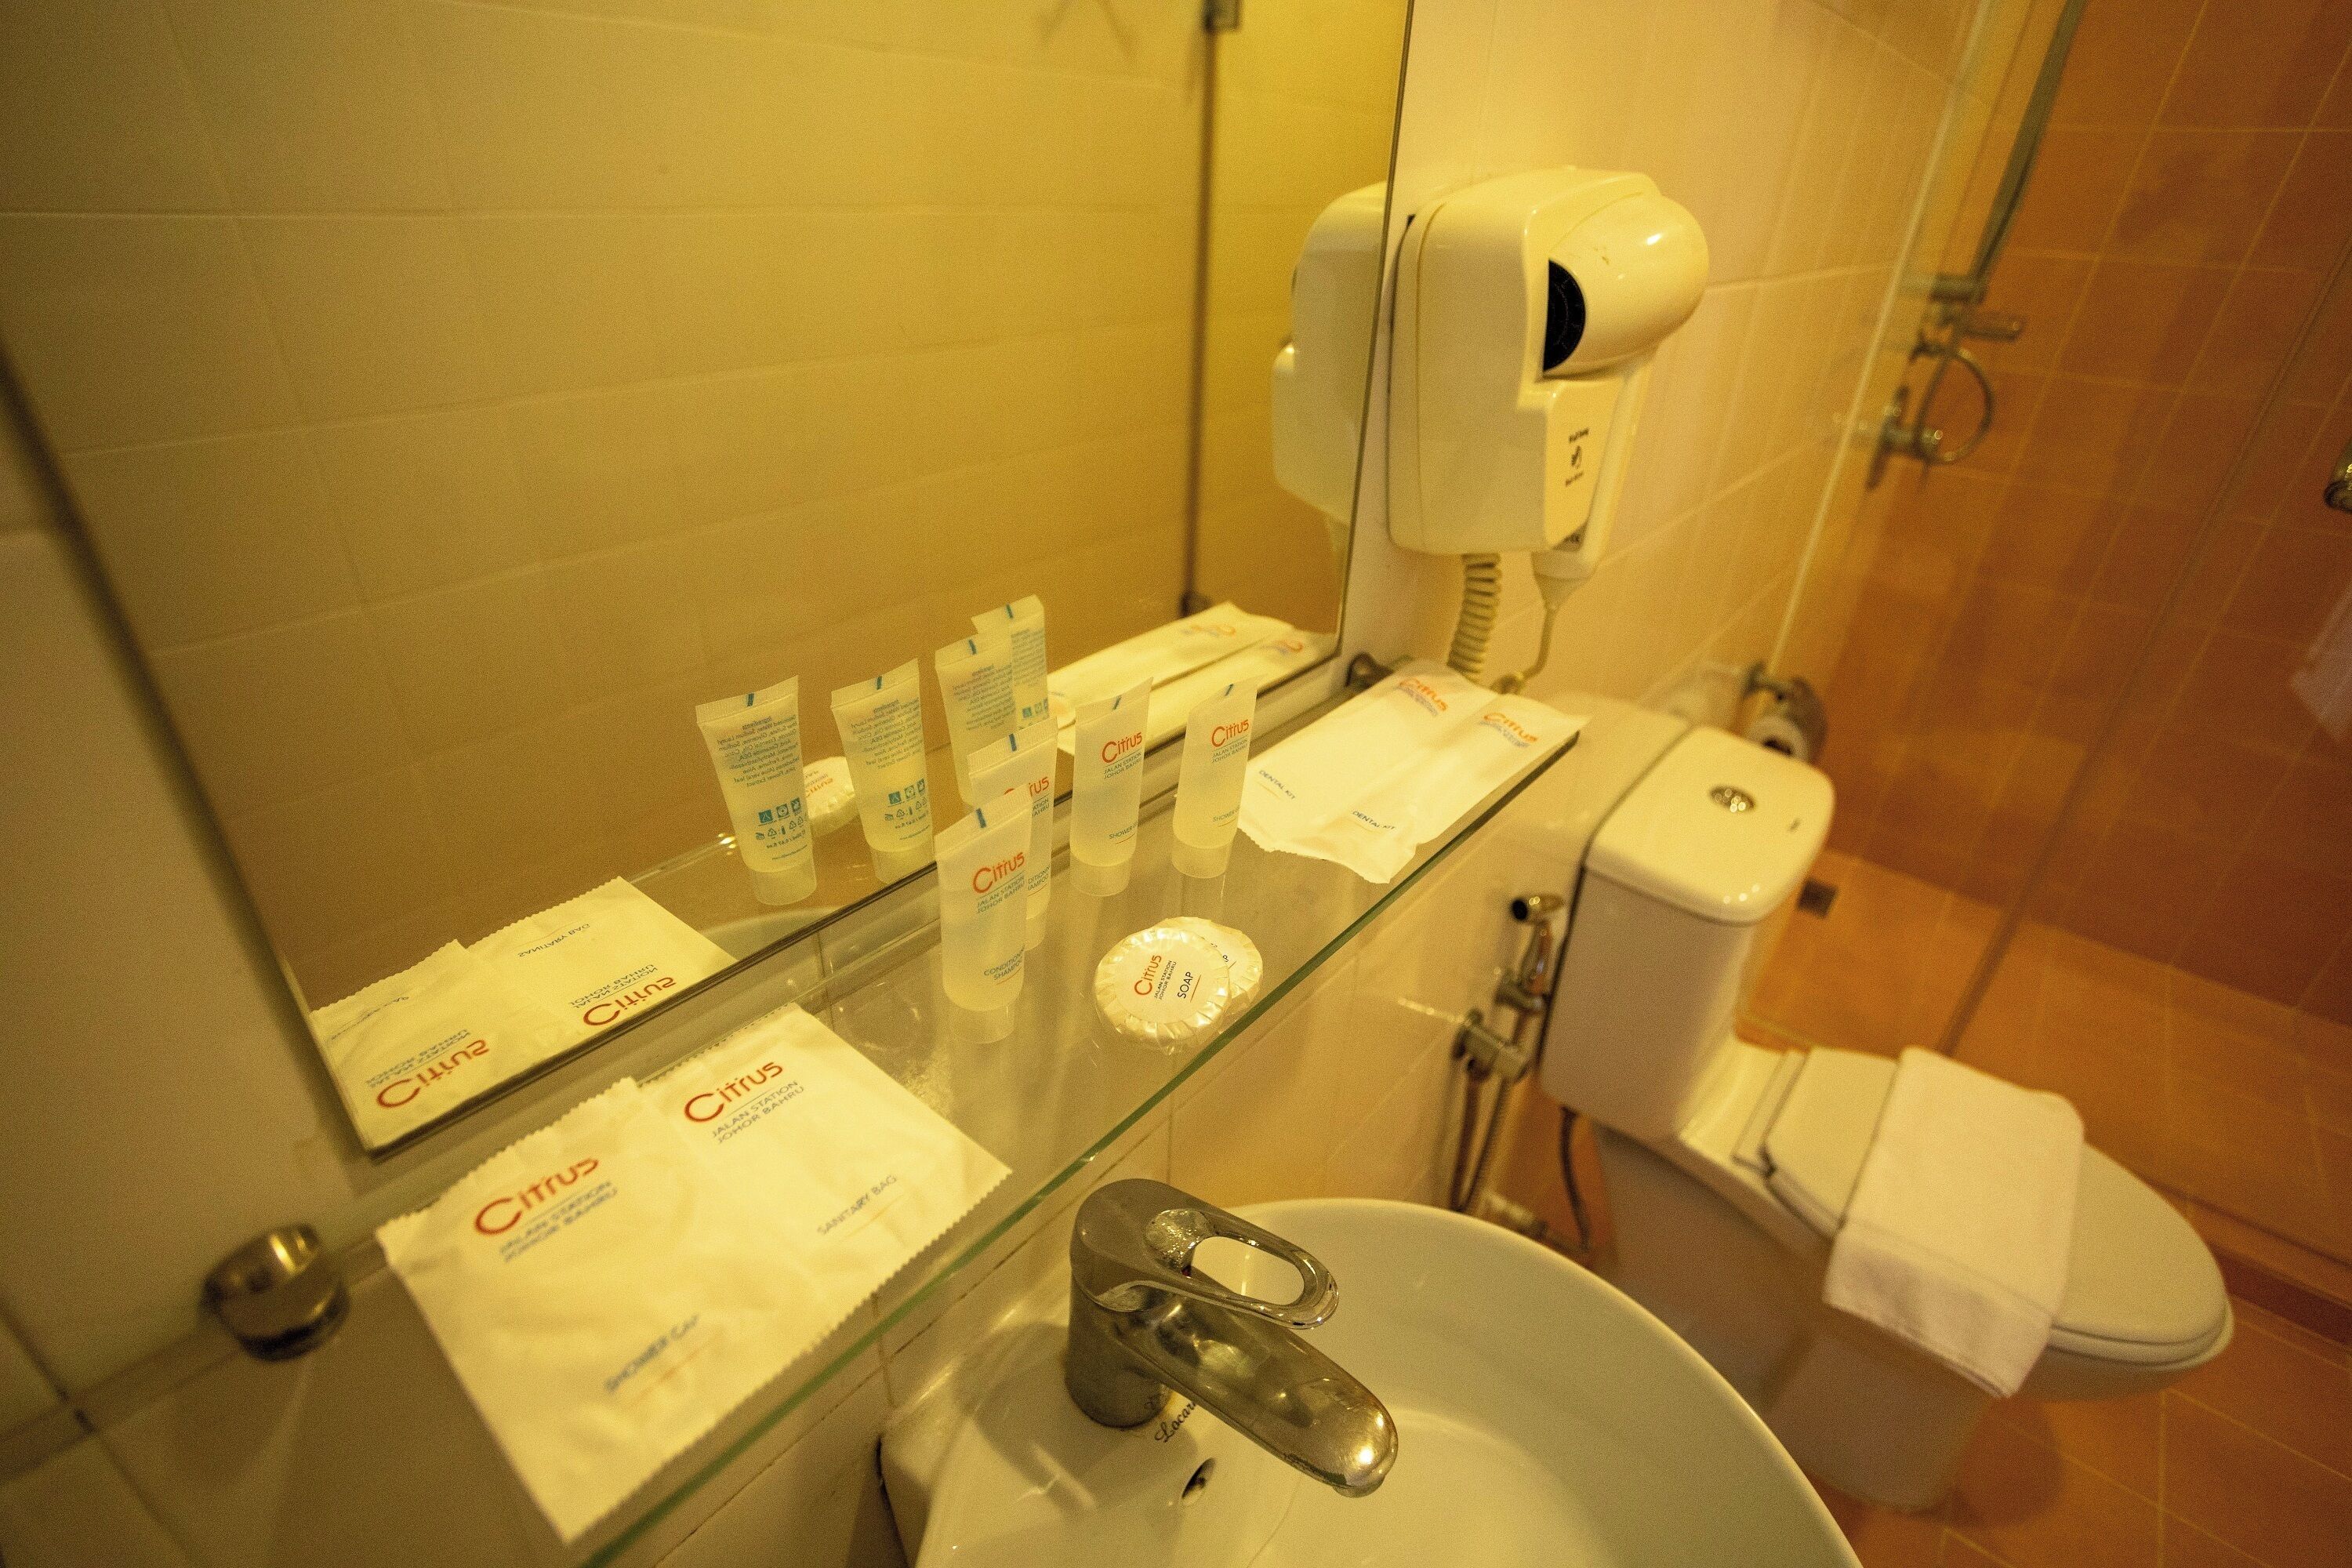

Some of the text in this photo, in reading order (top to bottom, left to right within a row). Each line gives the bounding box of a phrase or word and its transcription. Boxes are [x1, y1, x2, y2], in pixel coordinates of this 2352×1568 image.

[1102, 731, 1142, 763] Citrus
[1211, 719, 1249, 747] Citrus
[1212, 753, 1231, 764] JOHOR
[1213, 748, 1229, 758] JALAN
[1104, 763, 1123, 774] JALAN
[1104, 768, 1124, 780] JOHOR
[1258, 769, 1296, 800] DENTAL KIT
[1032, 803, 1050, 818] AHRU
[1352, 810, 1380, 828] DENTAL
[972, 851, 1025, 894] Citrus
[1028, 873, 1049, 891] AMPOO
[977, 891, 1000, 908] JALAN
[977, 896, 1004, 913] JOHOR
[1134, 955, 1162, 996] Citrus
[1154, 960, 1173, 1000] JALAN STATION
[1159, 961, 1177, 1000] JOHOR BAHRU
[1177, 971, 1194, 999] SOAP
[684, 1062, 783, 1123] Citrus
[712, 1080, 798, 1138] JALAN STATION
[717, 1086, 805, 1144] JOHOR BAHRU
[474, 1157, 599, 1236] Citrus
[817, 1174, 897, 1236] SANITARY BAG
